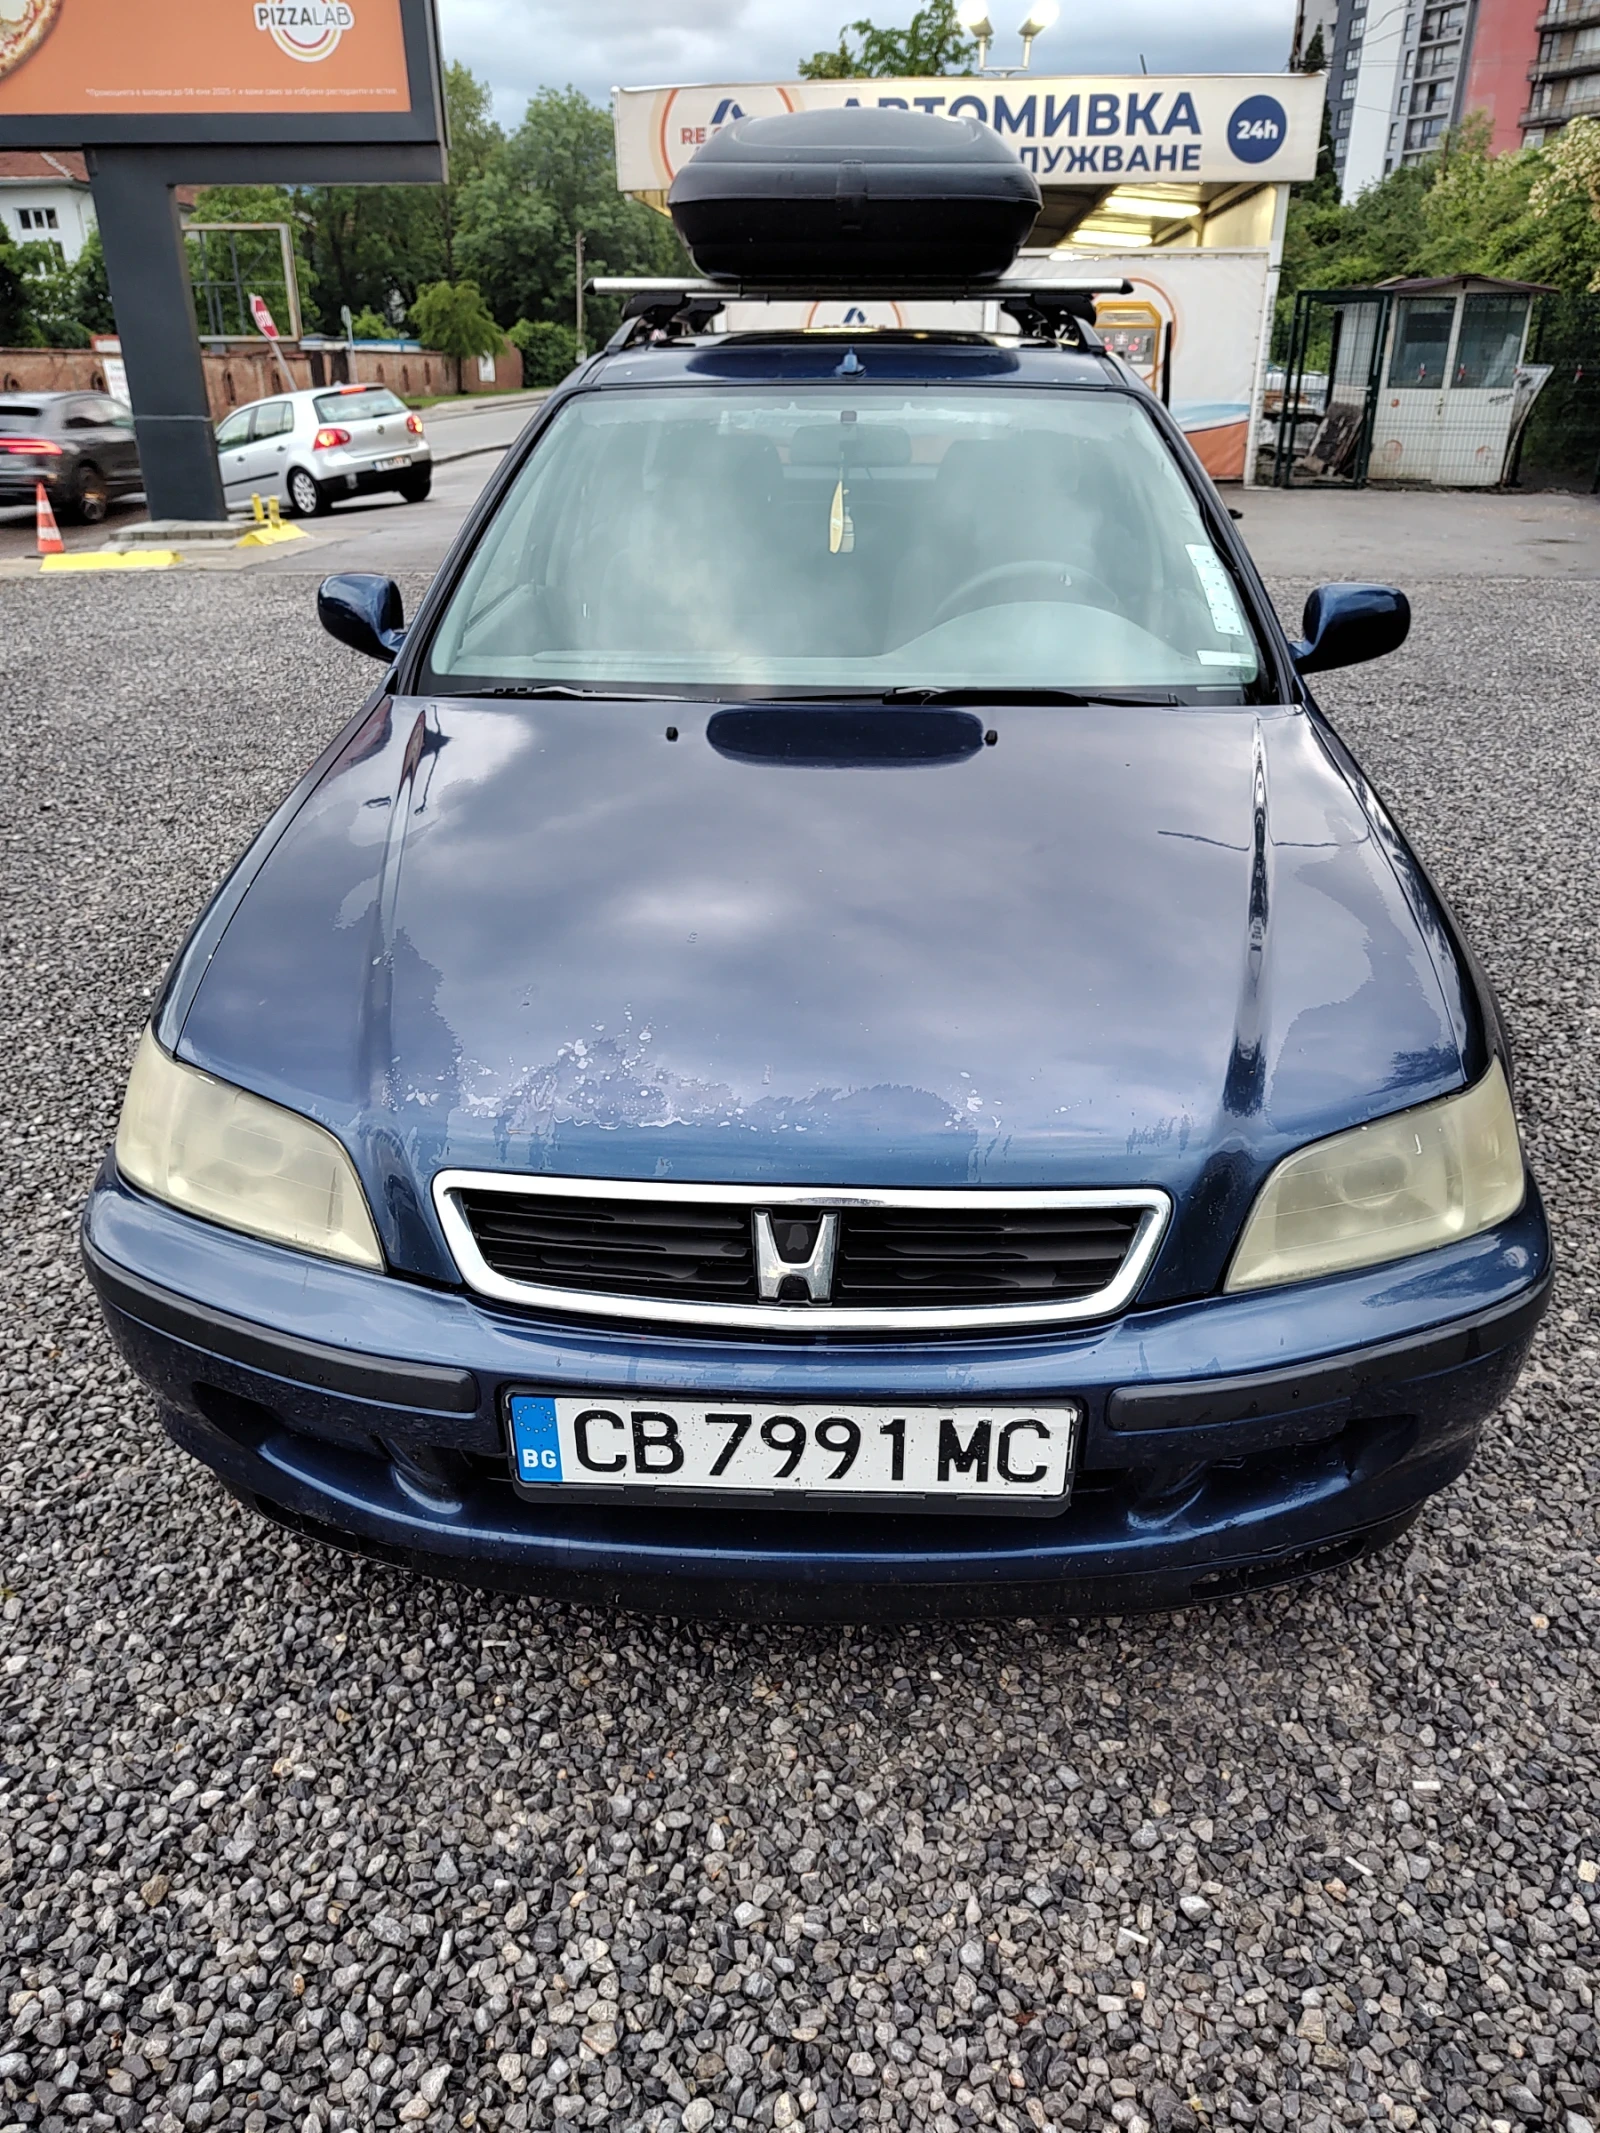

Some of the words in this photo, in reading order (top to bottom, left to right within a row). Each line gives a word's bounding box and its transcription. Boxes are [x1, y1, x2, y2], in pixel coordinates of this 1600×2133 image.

[257, 7, 352, 26] PIZZALAB
[1236, 119, 1280, 140] 24h
[1020, 144, 1202, 174] ЛУЖВАНЕ
[574, 1409, 684, 1475] CB
[704, 1412, 905, 1482] 7991
[938, 1417, 1051, 1484] MC
[522, 1448, 557, 1469] BG
